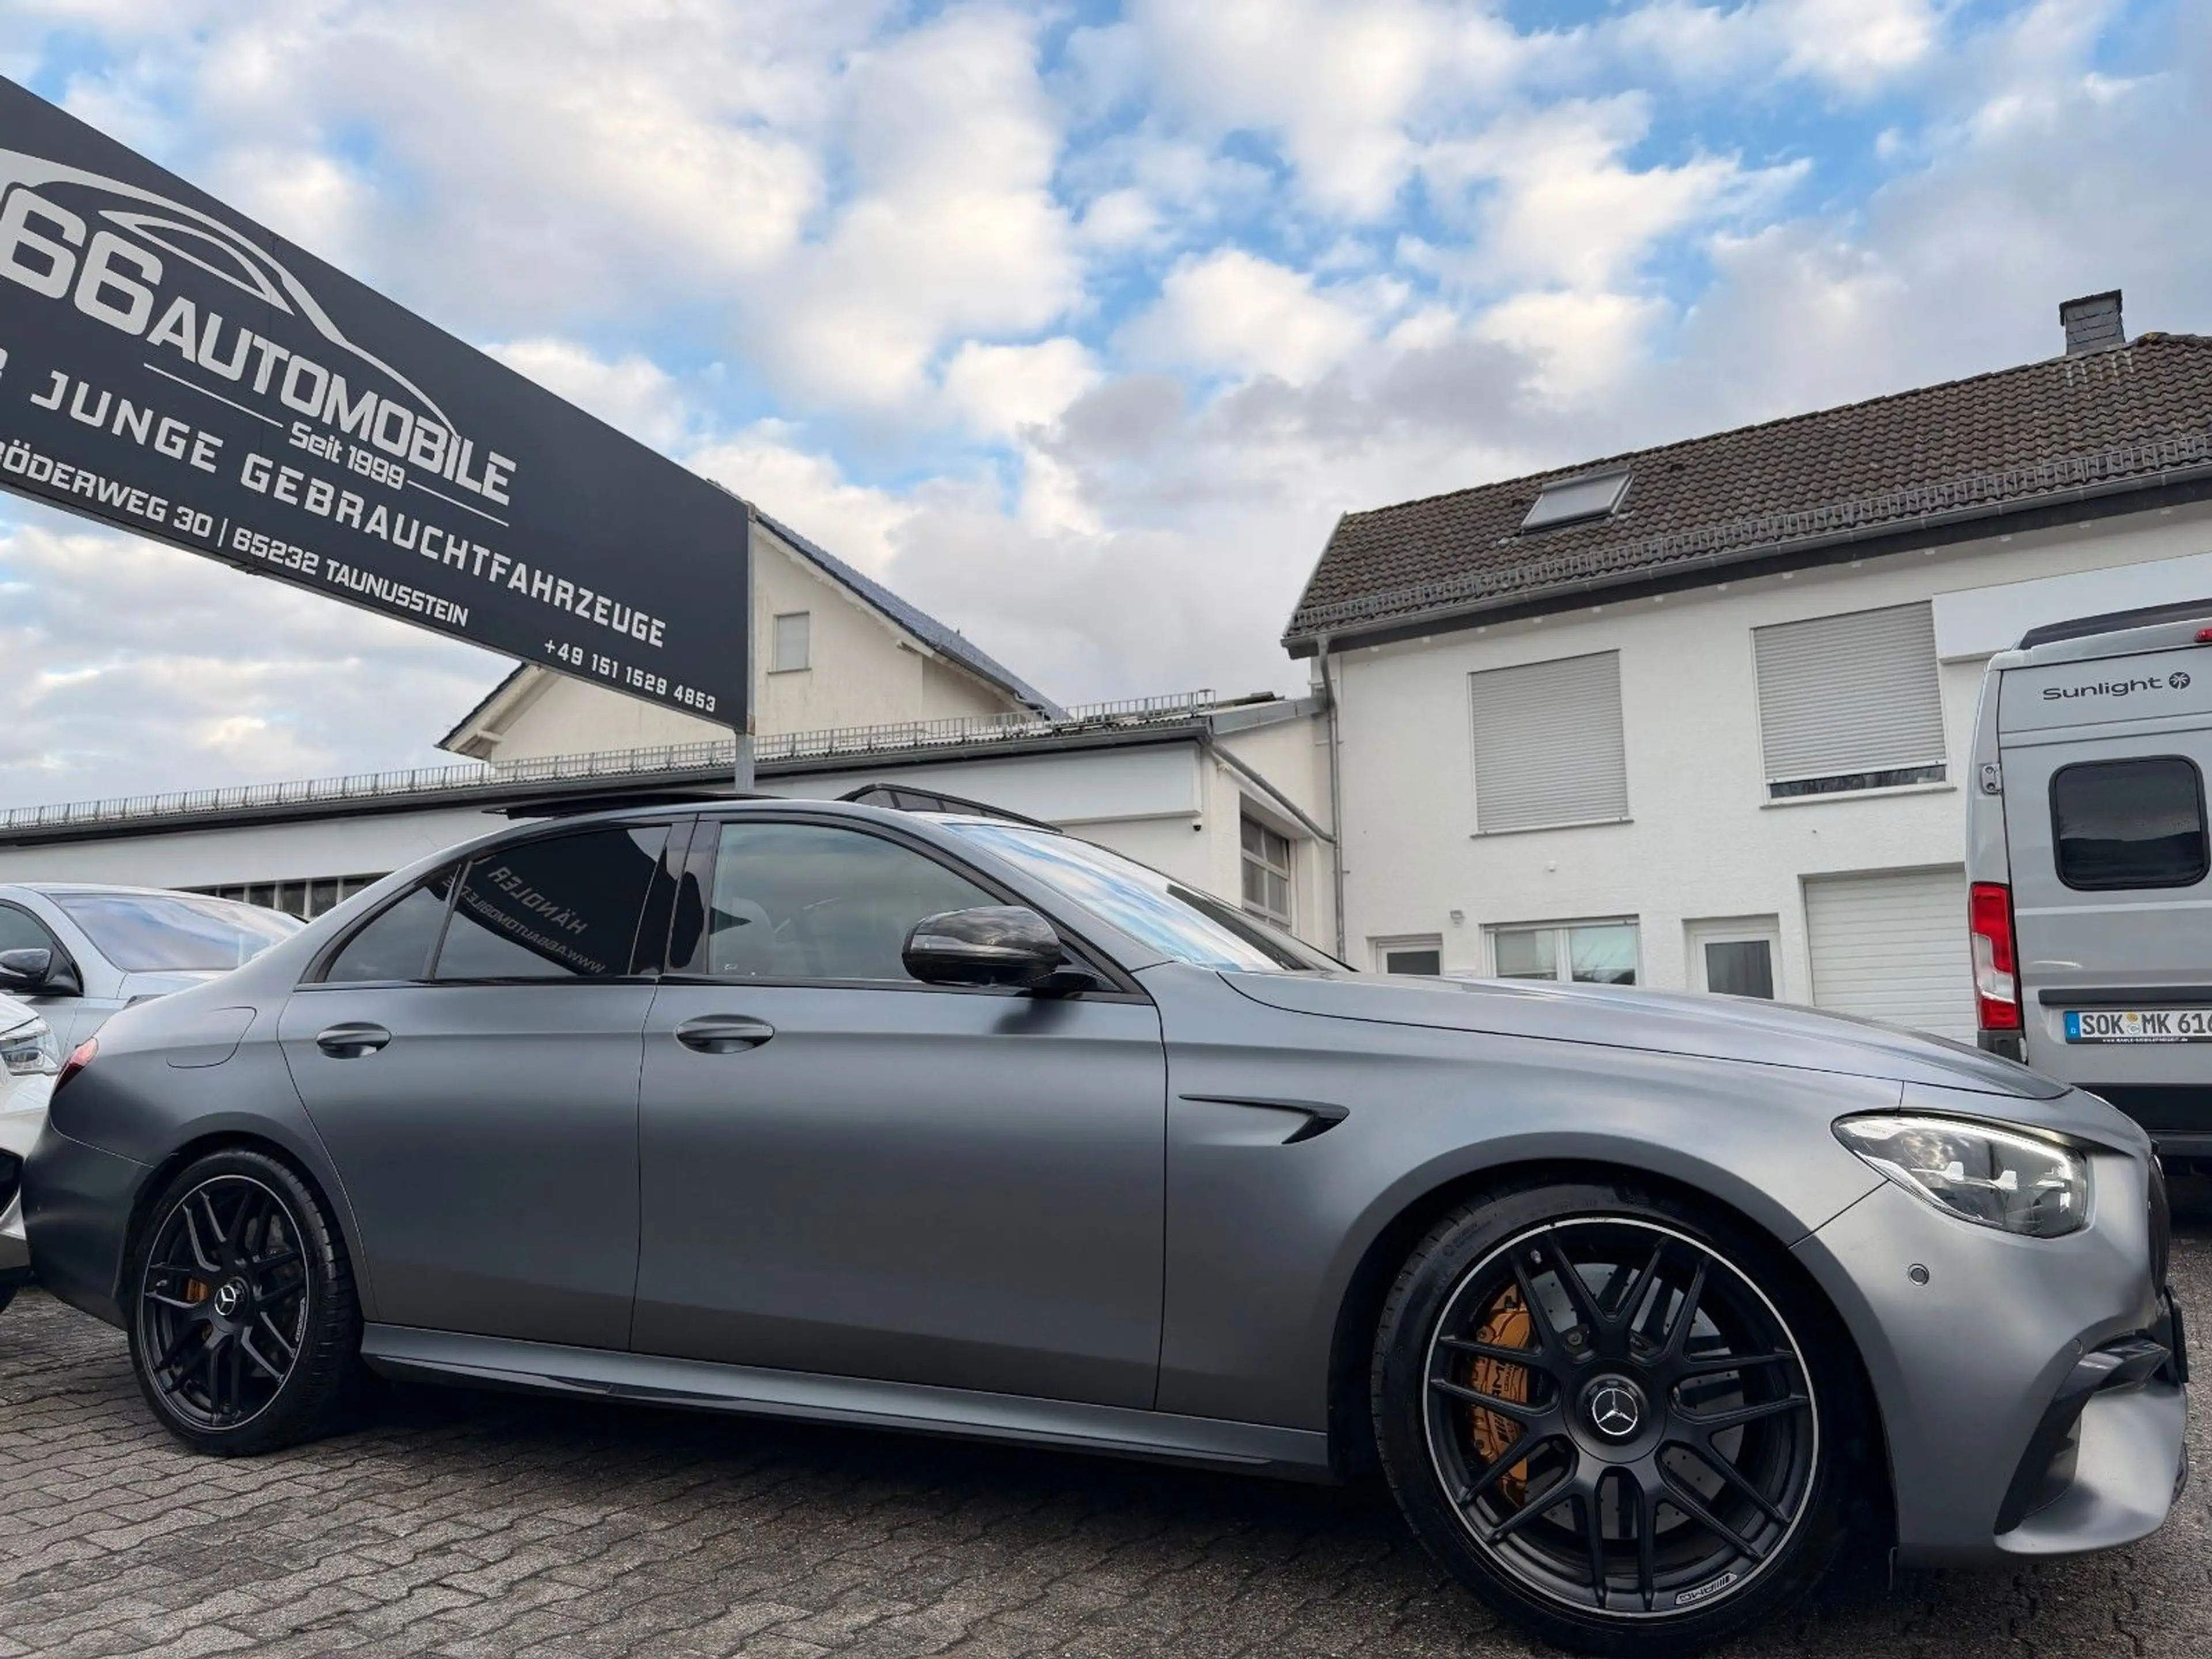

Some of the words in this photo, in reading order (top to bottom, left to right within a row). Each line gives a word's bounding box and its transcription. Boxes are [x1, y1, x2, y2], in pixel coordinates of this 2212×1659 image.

[289, 421, 342, 464] Seit
[347, 444, 405, 491] 1999
[0, 439, 168, 522] ÖDERWEG
[173, 506, 213, 537] 30
[232, 527, 320, 575] 65232
[326, 558, 468, 627] TAUNUSSTEIN
[30, 370, 224, 474] JUNGE
[240, 453, 666, 647] GEBRAUCHTFAHRZEUGE
[544, 639, 584, 666] +49
[592, 653, 619, 679] 151
[626, 666, 667, 695] 1529
[673, 685, 715, 712] 4853
[2043, 677, 2163, 700] Sunlight
[2082, 1014, 2124, 1035] SOK
[2142, 1013, 2171, 1035] MK
